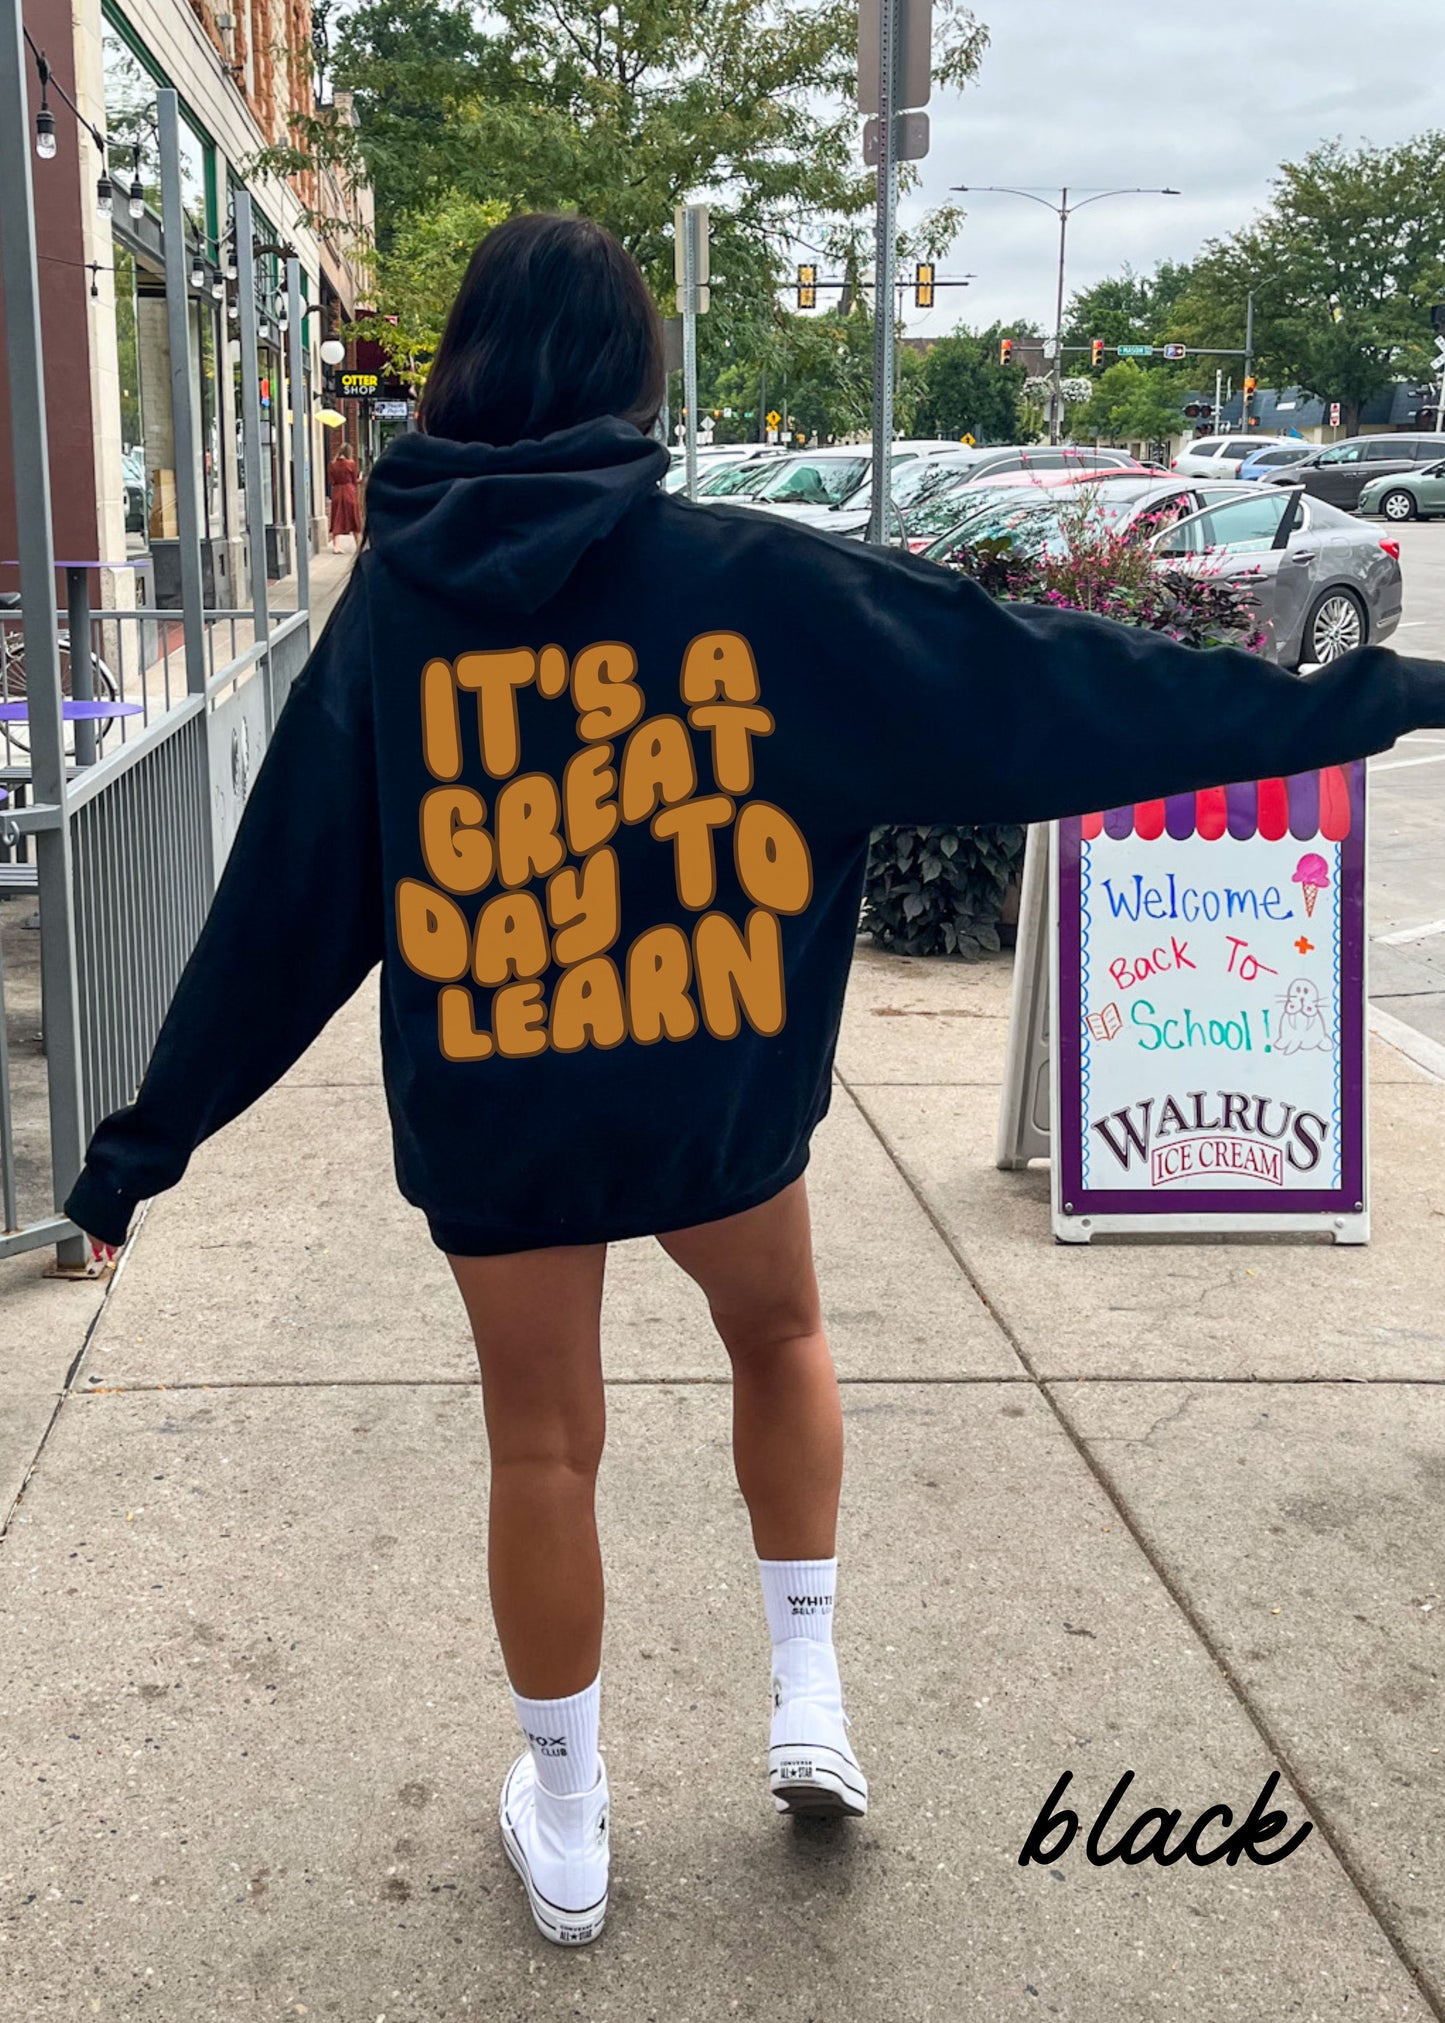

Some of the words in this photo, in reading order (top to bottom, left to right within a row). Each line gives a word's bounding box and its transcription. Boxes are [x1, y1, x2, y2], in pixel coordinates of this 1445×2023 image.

[341, 374, 378, 386] OTTER
[343, 385, 376, 395] SHOP
[420, 640, 646, 782] IT'S
[680, 630, 761, 703] A
[419, 700, 776, 896] GREAT
[395, 844, 621, 987] DAY
[651, 793, 814, 916] TO
[1101, 873, 1294, 922] Welcome
[1225, 935, 1279, 981] To
[438, 907, 787, 1063] LEARN
[1090, 1090, 1330, 1172] WALRUS
[1157, 1144, 1193, 1179] ICE
[1199, 1141, 1280, 1181] CREAM
[541, 1748, 567, 1757] CLUB
